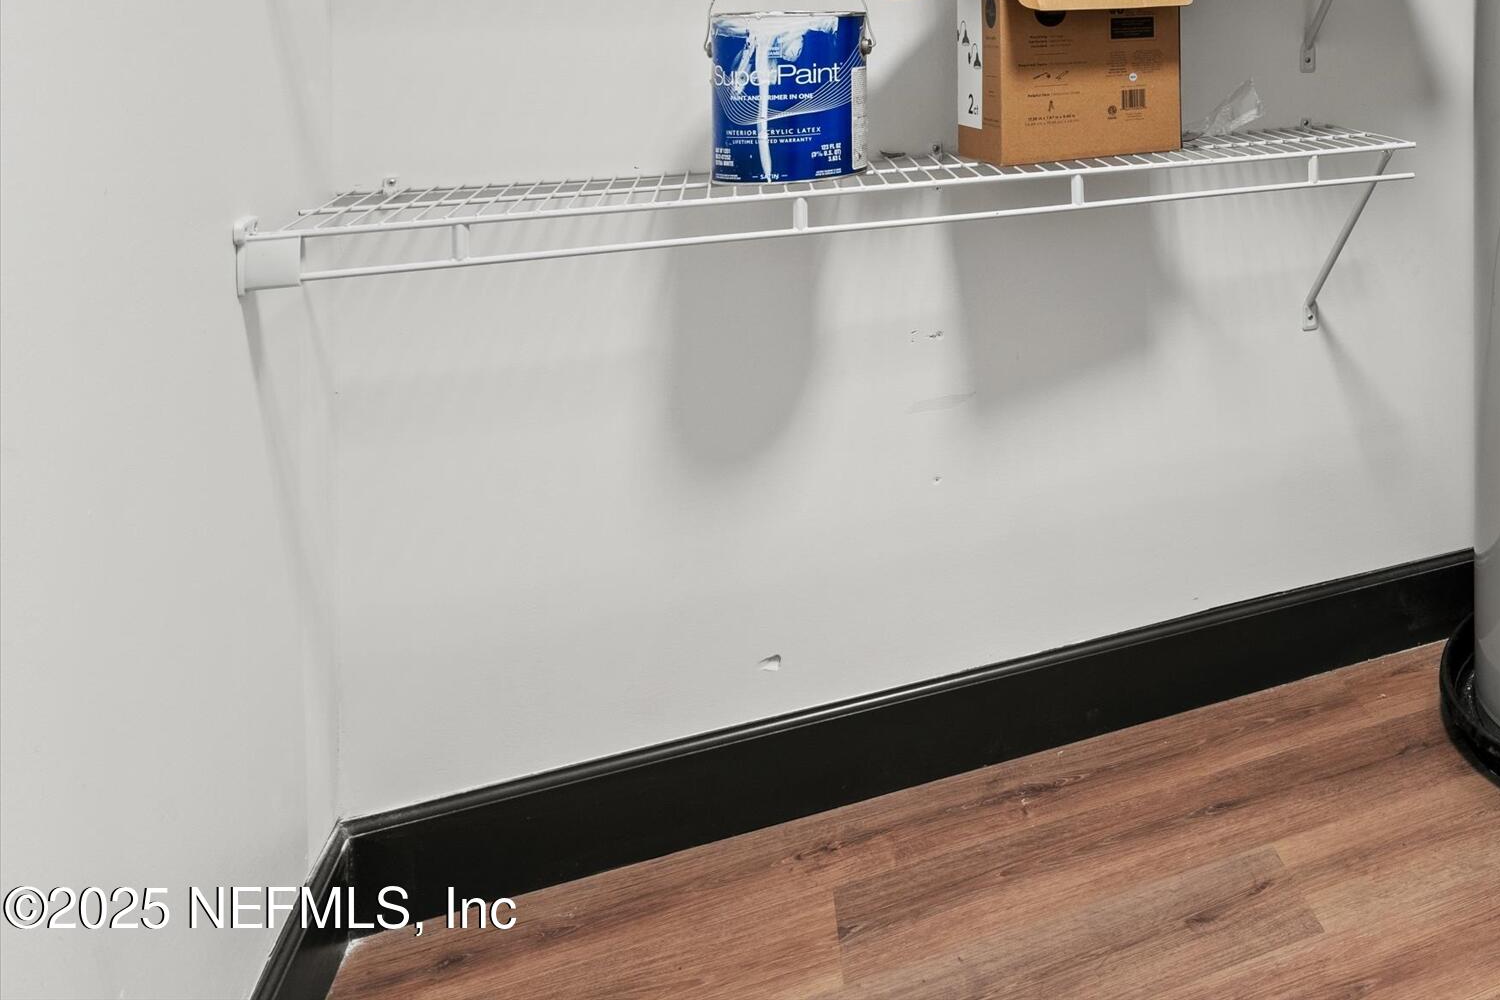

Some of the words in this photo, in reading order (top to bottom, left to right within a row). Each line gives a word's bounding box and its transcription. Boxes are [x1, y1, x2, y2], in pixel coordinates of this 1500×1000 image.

[714, 62, 841, 87] SupePaint
[968, 93, 974, 115] 2
[725, 129, 758, 137] INTERIOR
[767, 127, 794, 135] CRYLIC
[797, 126, 822, 134] LATEX
[779, 136, 813, 144] WARRANTY
